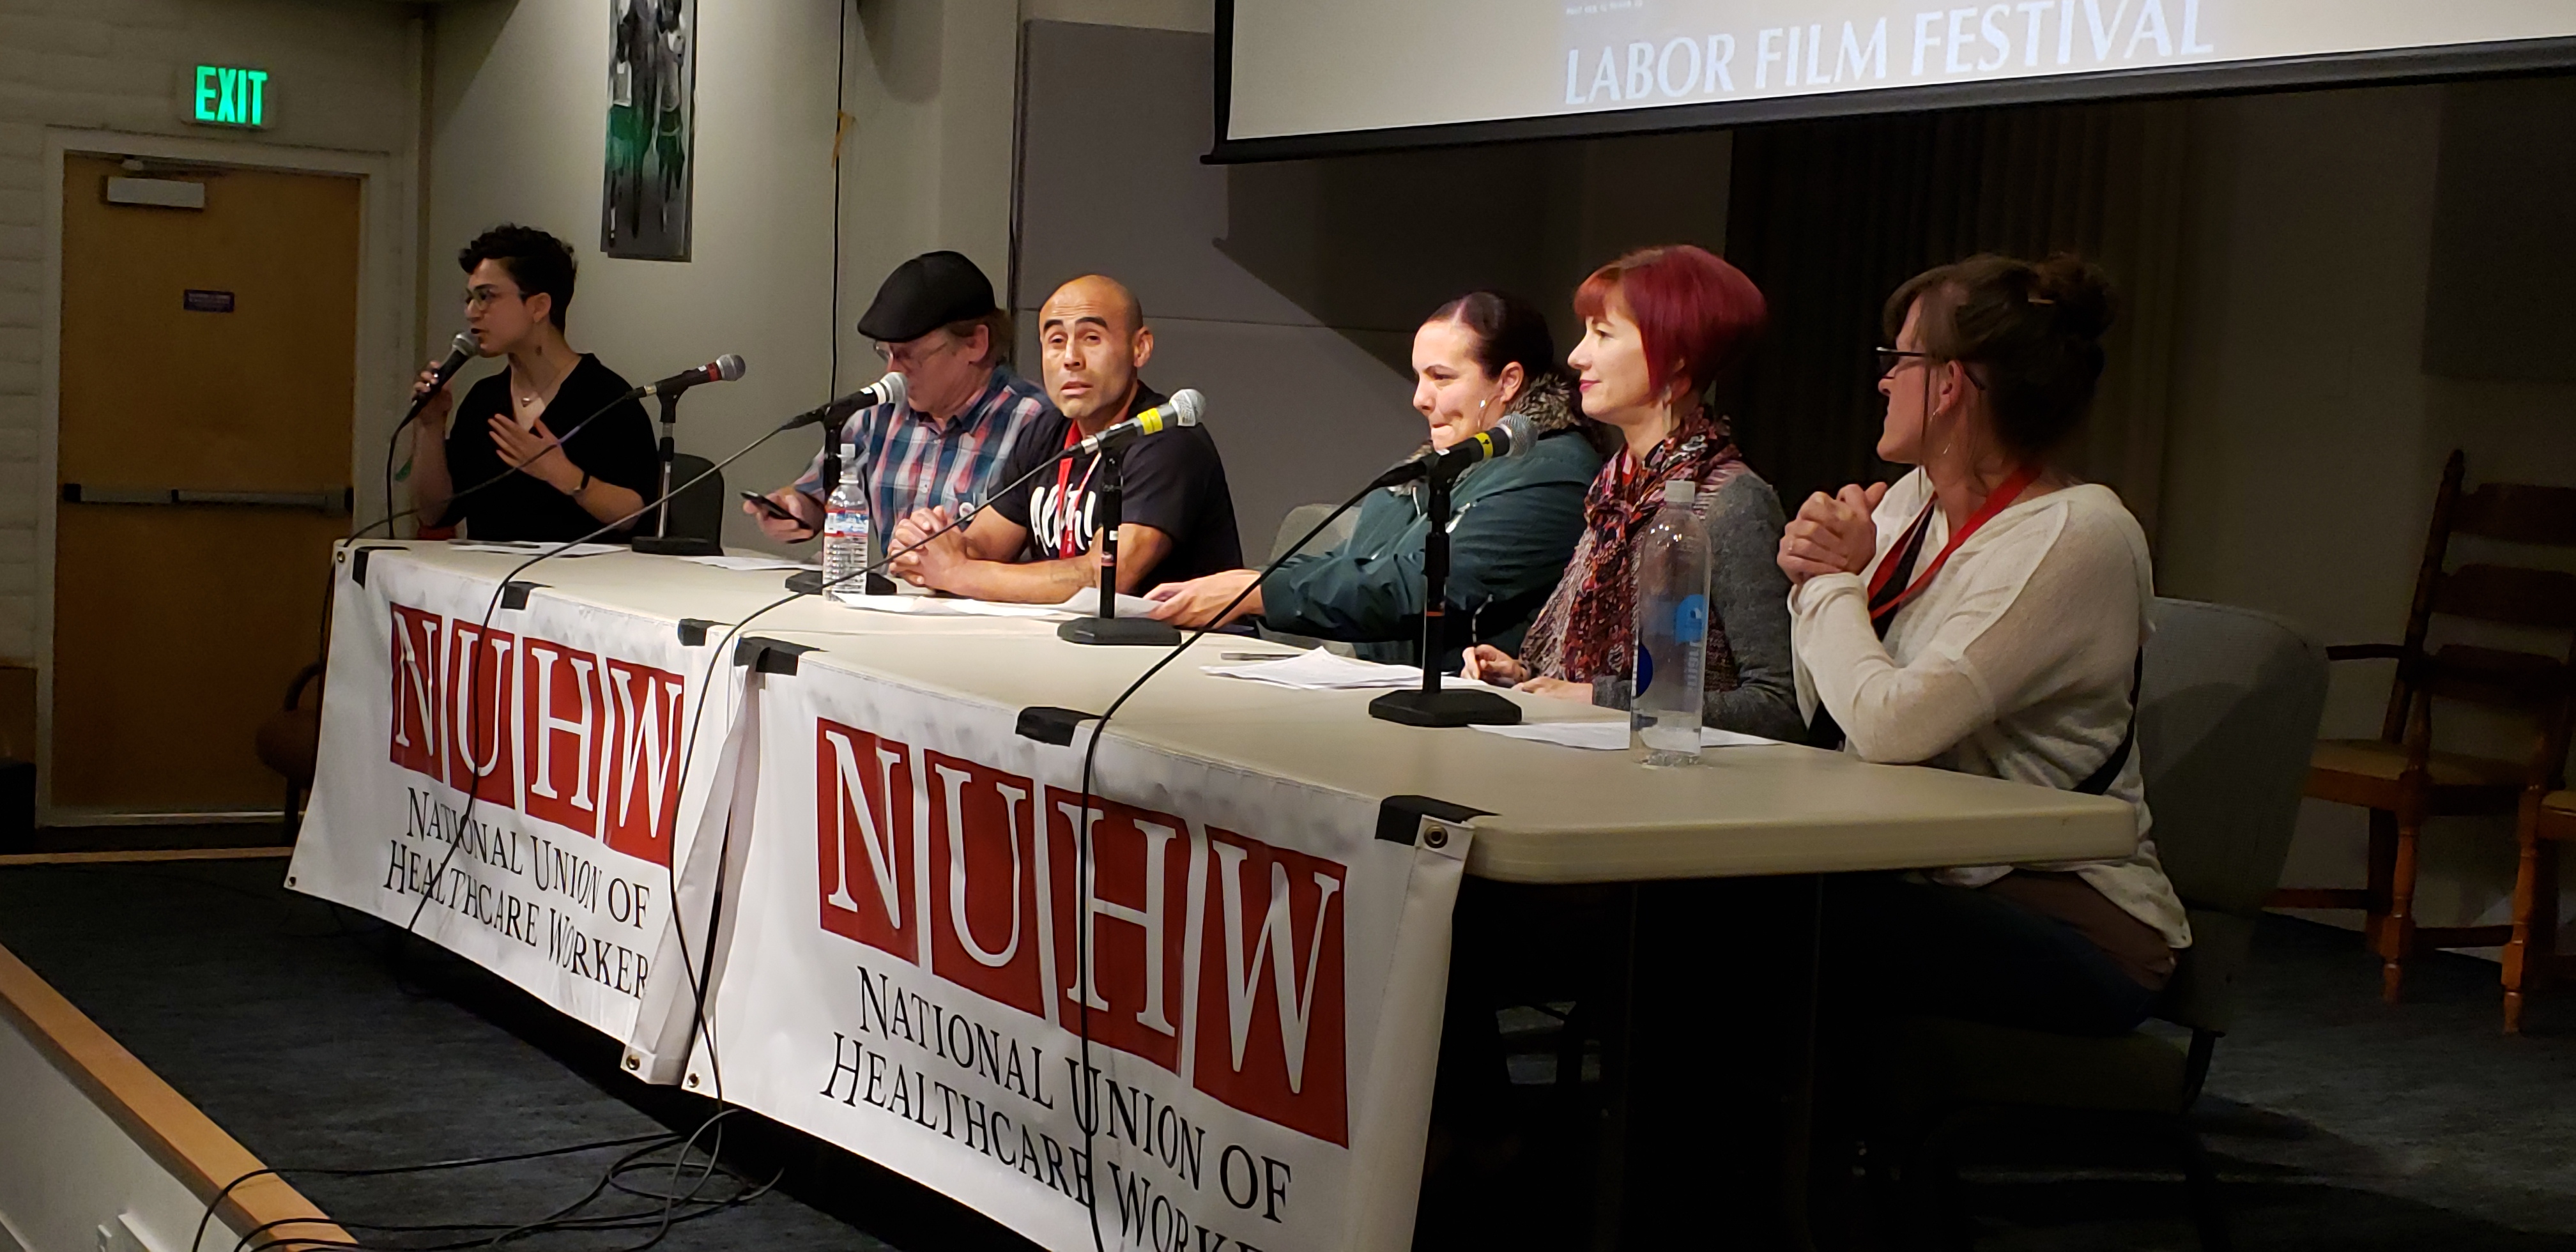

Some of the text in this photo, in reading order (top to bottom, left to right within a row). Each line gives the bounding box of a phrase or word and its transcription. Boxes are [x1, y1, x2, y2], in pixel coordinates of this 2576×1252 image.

[195, 65, 268, 125] EXIT
[1565, 0, 2214, 105] LABOR FILM FESTIVAL
[394, 611, 682, 839] NUHW
[383, 839, 539, 947] HEALTHCARE
[406, 786, 650, 930] NATIONAL UNION OF
[825, 729, 1340, 1094] NUHW
[820, 1032, 1264, 1252] HEALTHCARE WOR
[857, 966, 1292, 1224] NATIONAL UNION OF
